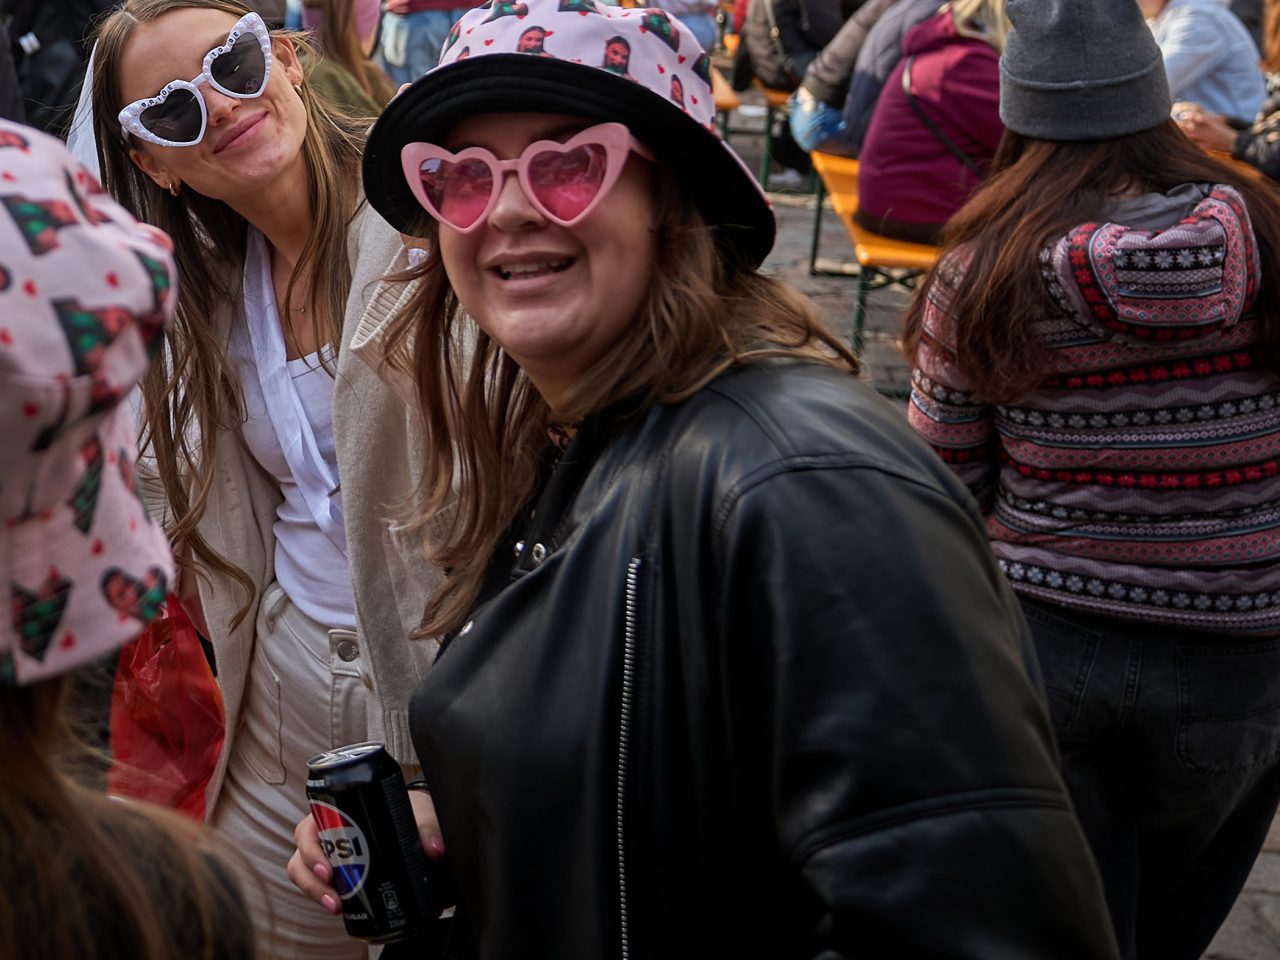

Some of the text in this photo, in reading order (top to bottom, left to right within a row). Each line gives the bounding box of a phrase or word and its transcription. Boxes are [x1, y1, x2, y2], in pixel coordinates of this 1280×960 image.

[141, 31, 240, 108] BRIDE TO BE
[319, 836, 363, 859] PSI
